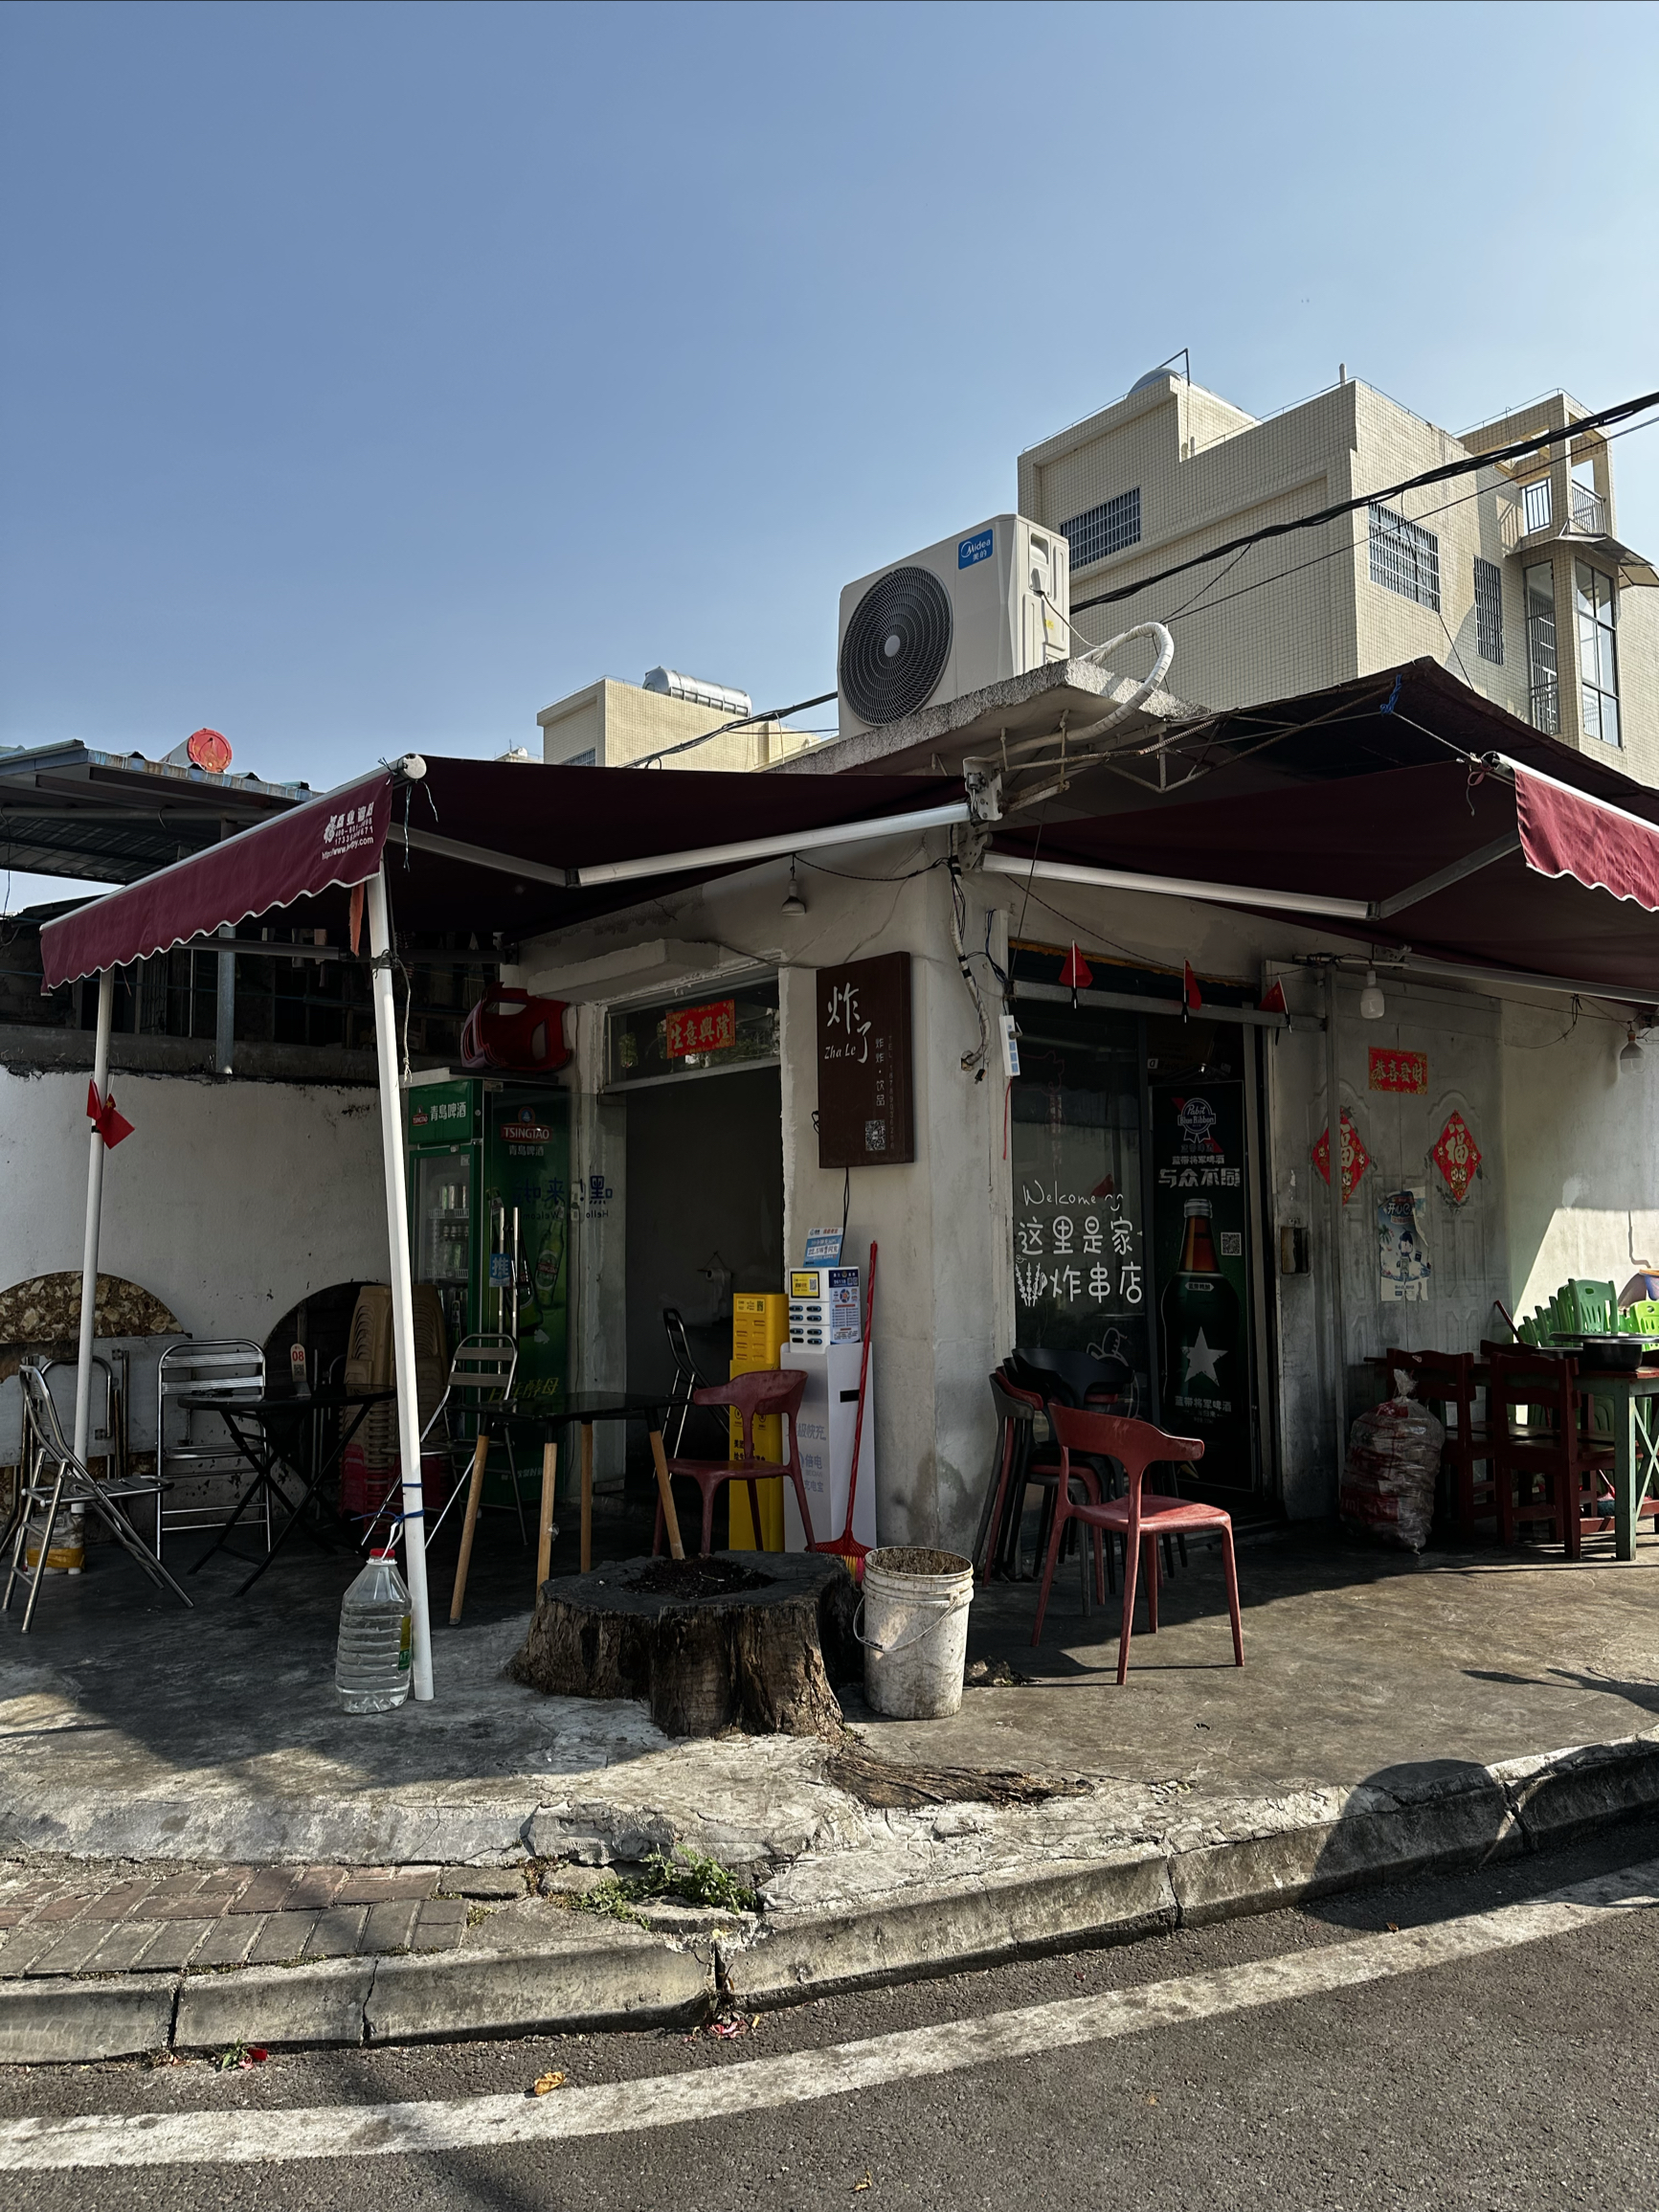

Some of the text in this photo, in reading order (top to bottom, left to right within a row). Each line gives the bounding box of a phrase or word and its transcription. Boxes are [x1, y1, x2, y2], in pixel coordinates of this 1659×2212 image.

[960, 539, 991, 558] Midea
[973, 550, 987, 561] 美的
[826, 982, 872, 1064] 炸了
[824, 1043, 857, 1060] Zha Le
[503, 1126, 550, 1140] TSINGTAO
[1446, 1122, 1469, 1165] 福
[1158, 1167, 1241, 1188] 与众不同
[1022, 1179, 1096, 1207] Welcome
[1018, 1216, 1133, 1256] 这里是家
[491, 1256, 509, 1277] 推
[1050, 1261, 1142, 1304] 炸串店
[292, 1350, 304, 1362] 08
